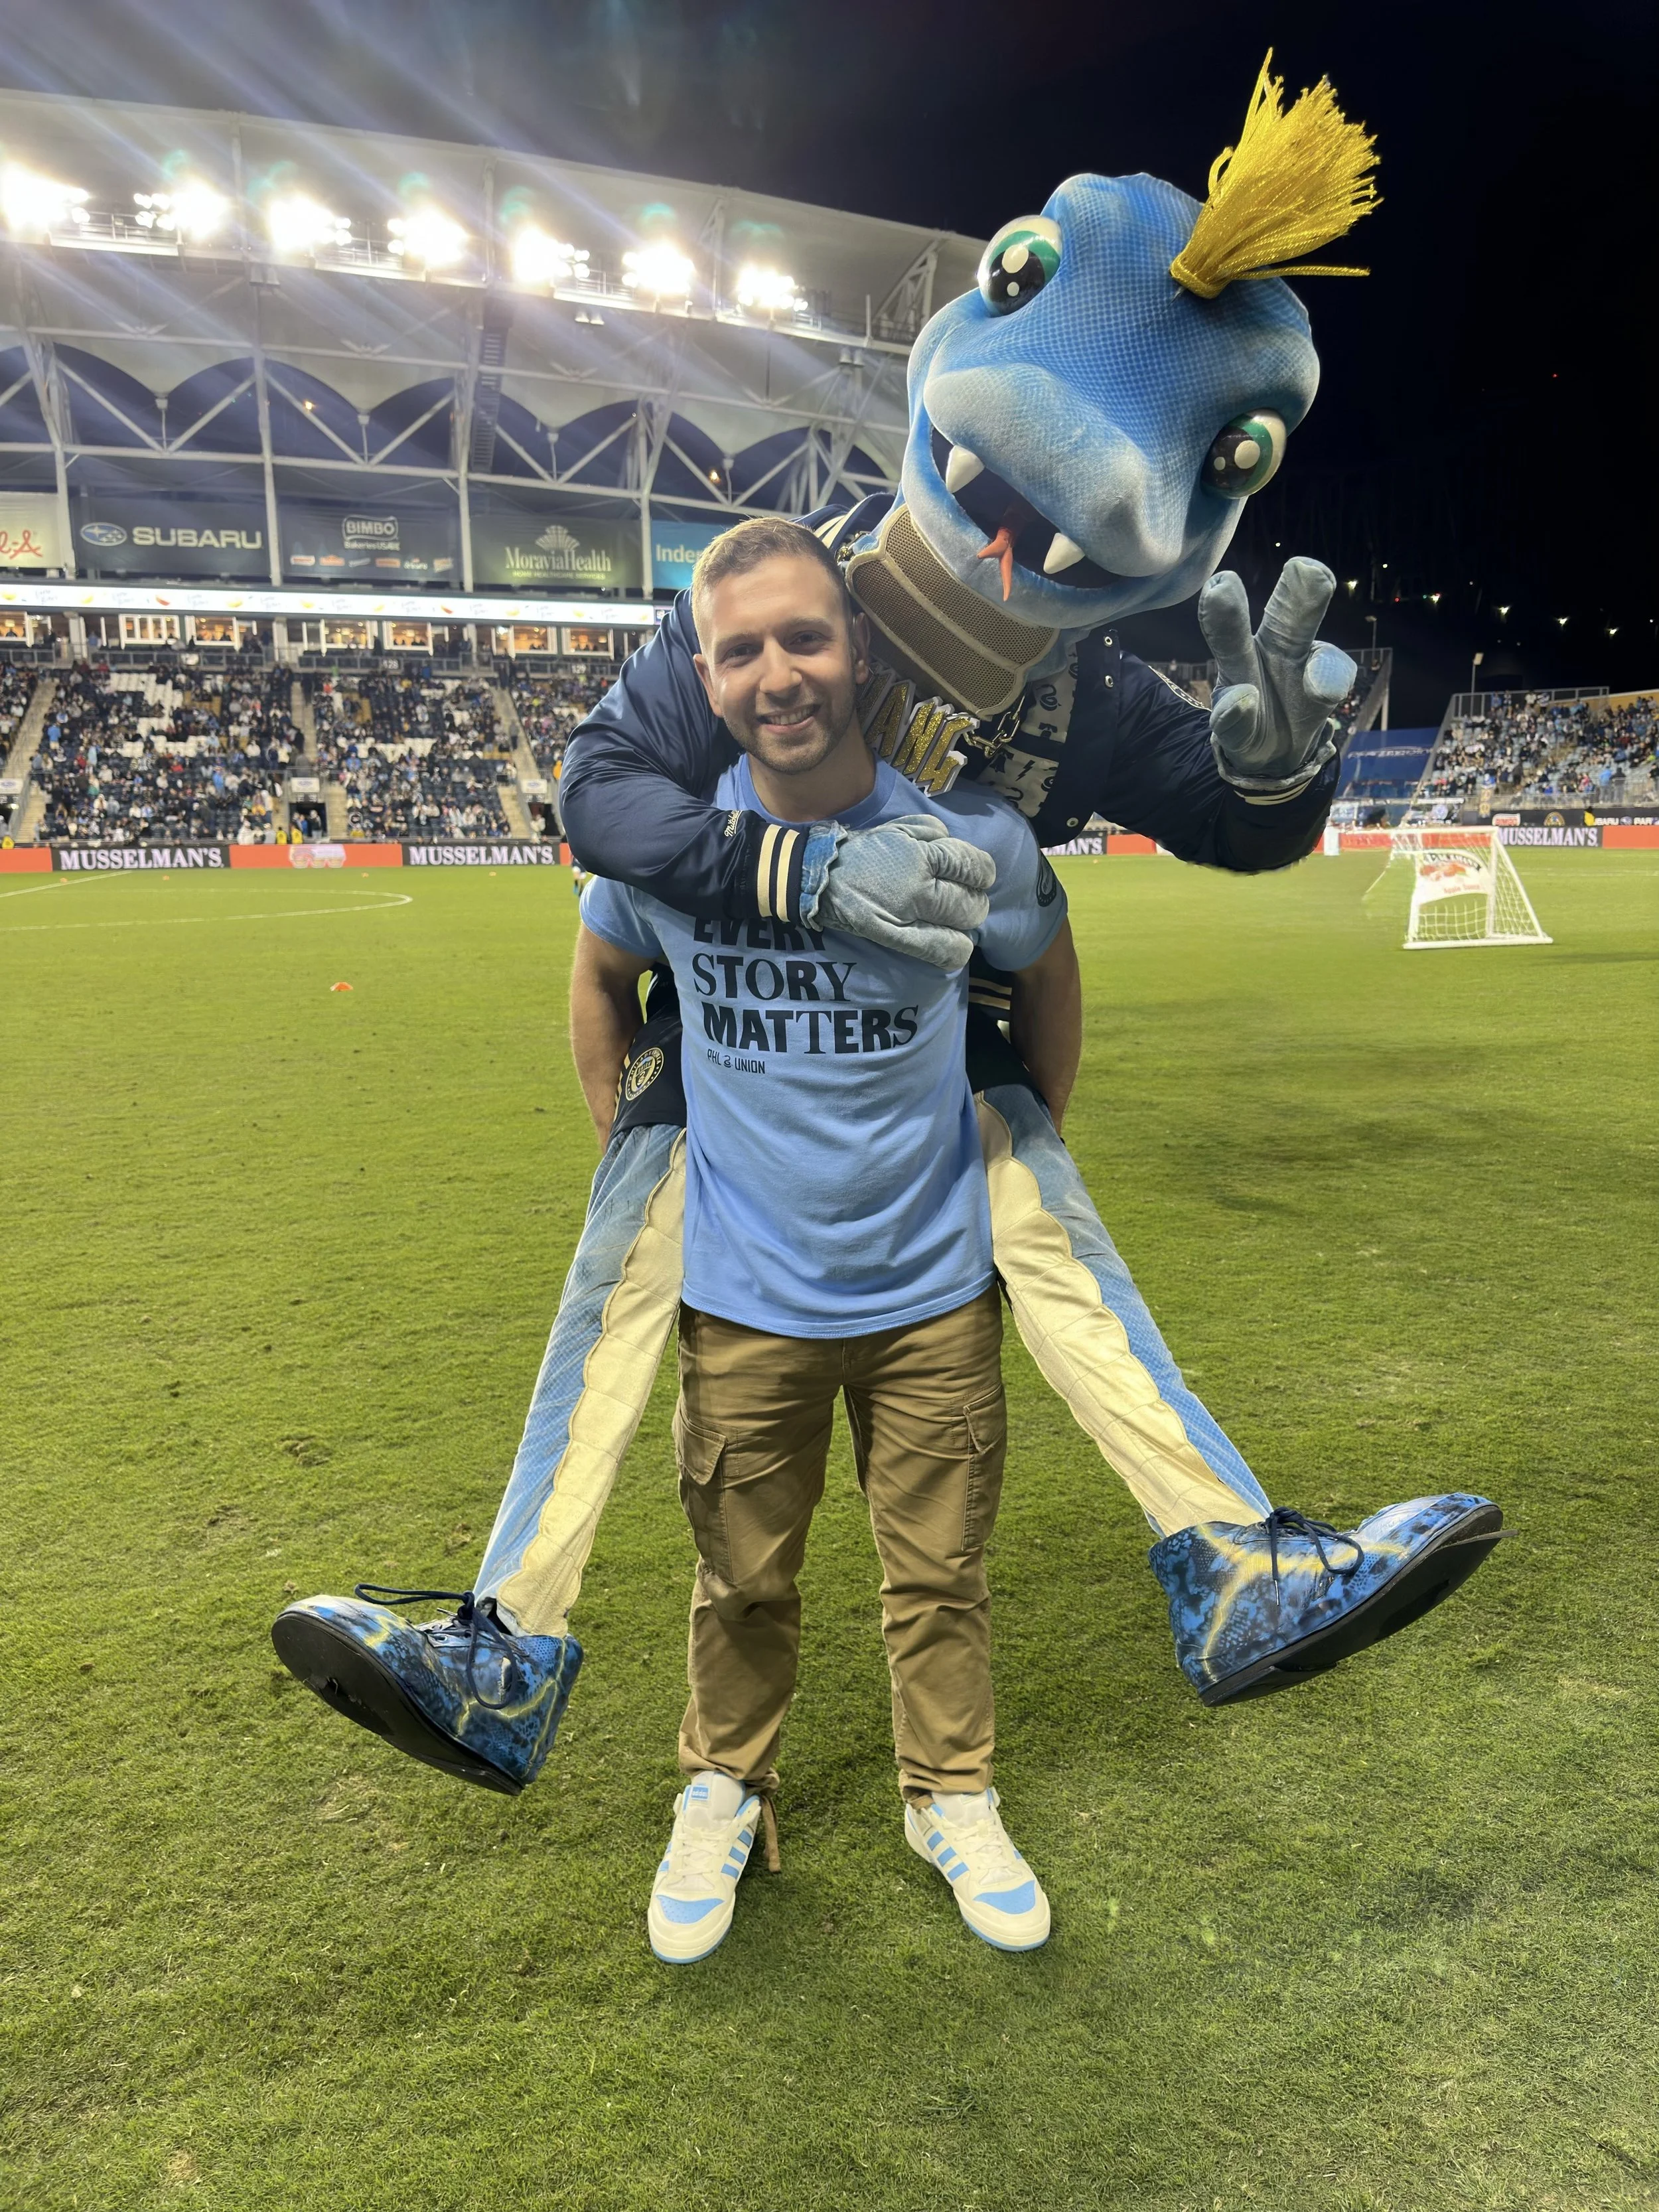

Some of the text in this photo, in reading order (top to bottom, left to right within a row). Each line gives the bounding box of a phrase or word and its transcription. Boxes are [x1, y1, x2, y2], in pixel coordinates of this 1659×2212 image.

[133, 526, 262, 550] SUBARU
[345, 521, 396, 536] BIMBO
[1498, 827, 1598, 846] MUSSELMAN'S
[59, 848, 222, 870] MUSSELMAN'S
[409, 846, 553, 865] MUSSELMAN'S
[692, 953, 857, 1002] STORY
[701, 1001, 919, 1054] MATTERS
[707, 1049, 766, 1074] PHL UNION
